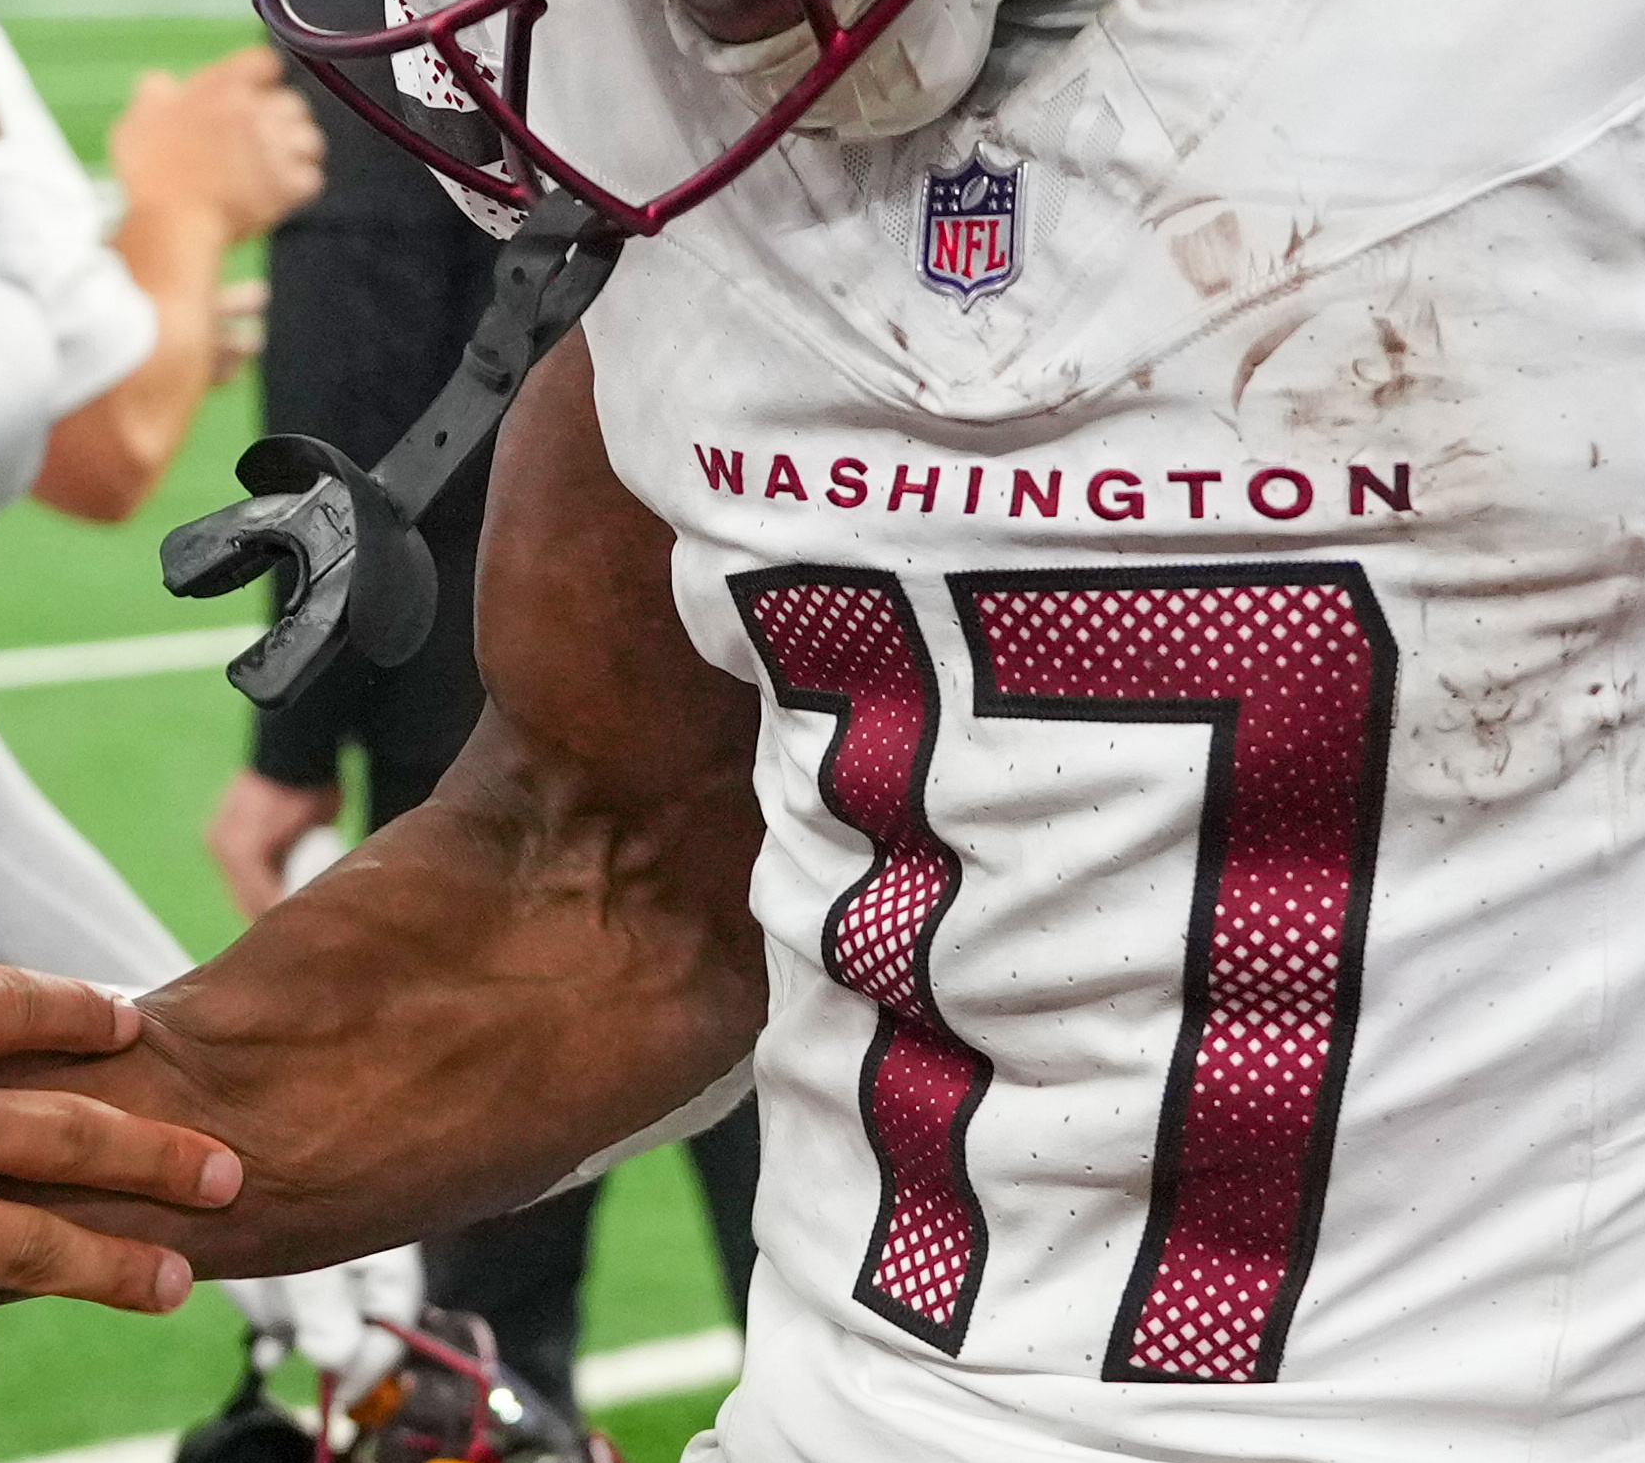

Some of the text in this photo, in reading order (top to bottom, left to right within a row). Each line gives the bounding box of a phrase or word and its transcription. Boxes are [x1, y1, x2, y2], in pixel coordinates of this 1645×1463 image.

[932, 219, 1007, 280] NFL
[693, 442, 1416, 522] WASHINGTON
[725, 561, 1400, 1384] 17
